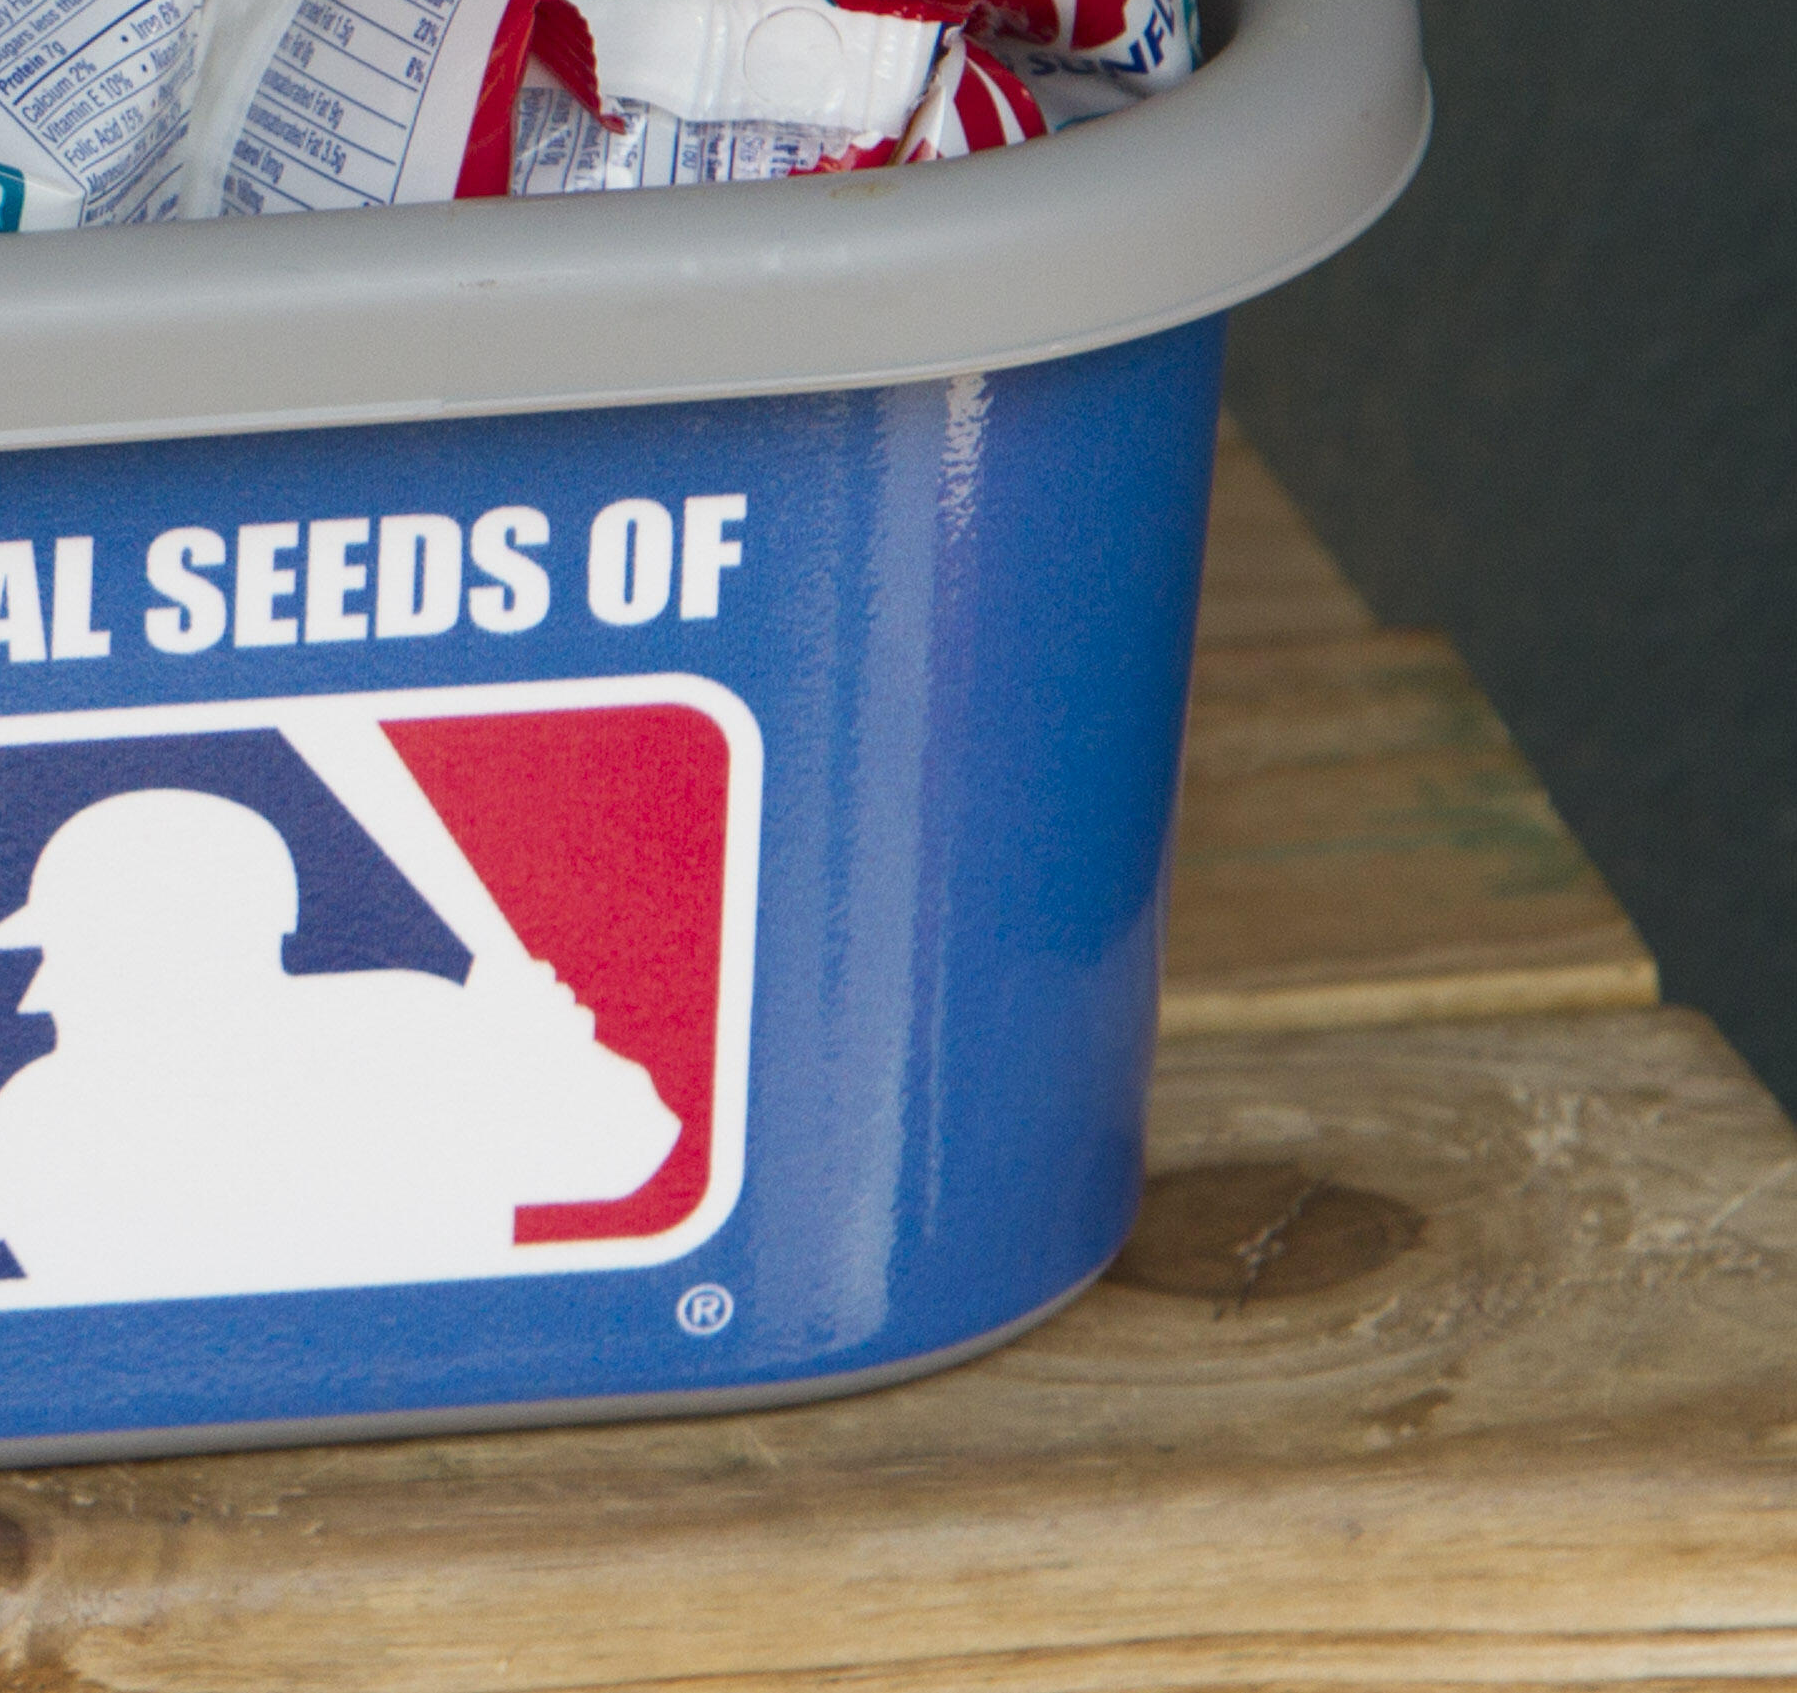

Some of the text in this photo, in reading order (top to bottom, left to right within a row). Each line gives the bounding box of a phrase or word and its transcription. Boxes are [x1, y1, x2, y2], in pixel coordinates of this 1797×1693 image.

[43, 39, 69, 57] 7g
[21, 58, 97, 123] Calcium 2%
[41, 69, 134, 144] Vitamin 10%
[63, 115, 124, 168] Folic Acid
[143, 505, 552, 656] SEEDS
[586, 494, 749, 630] OF
